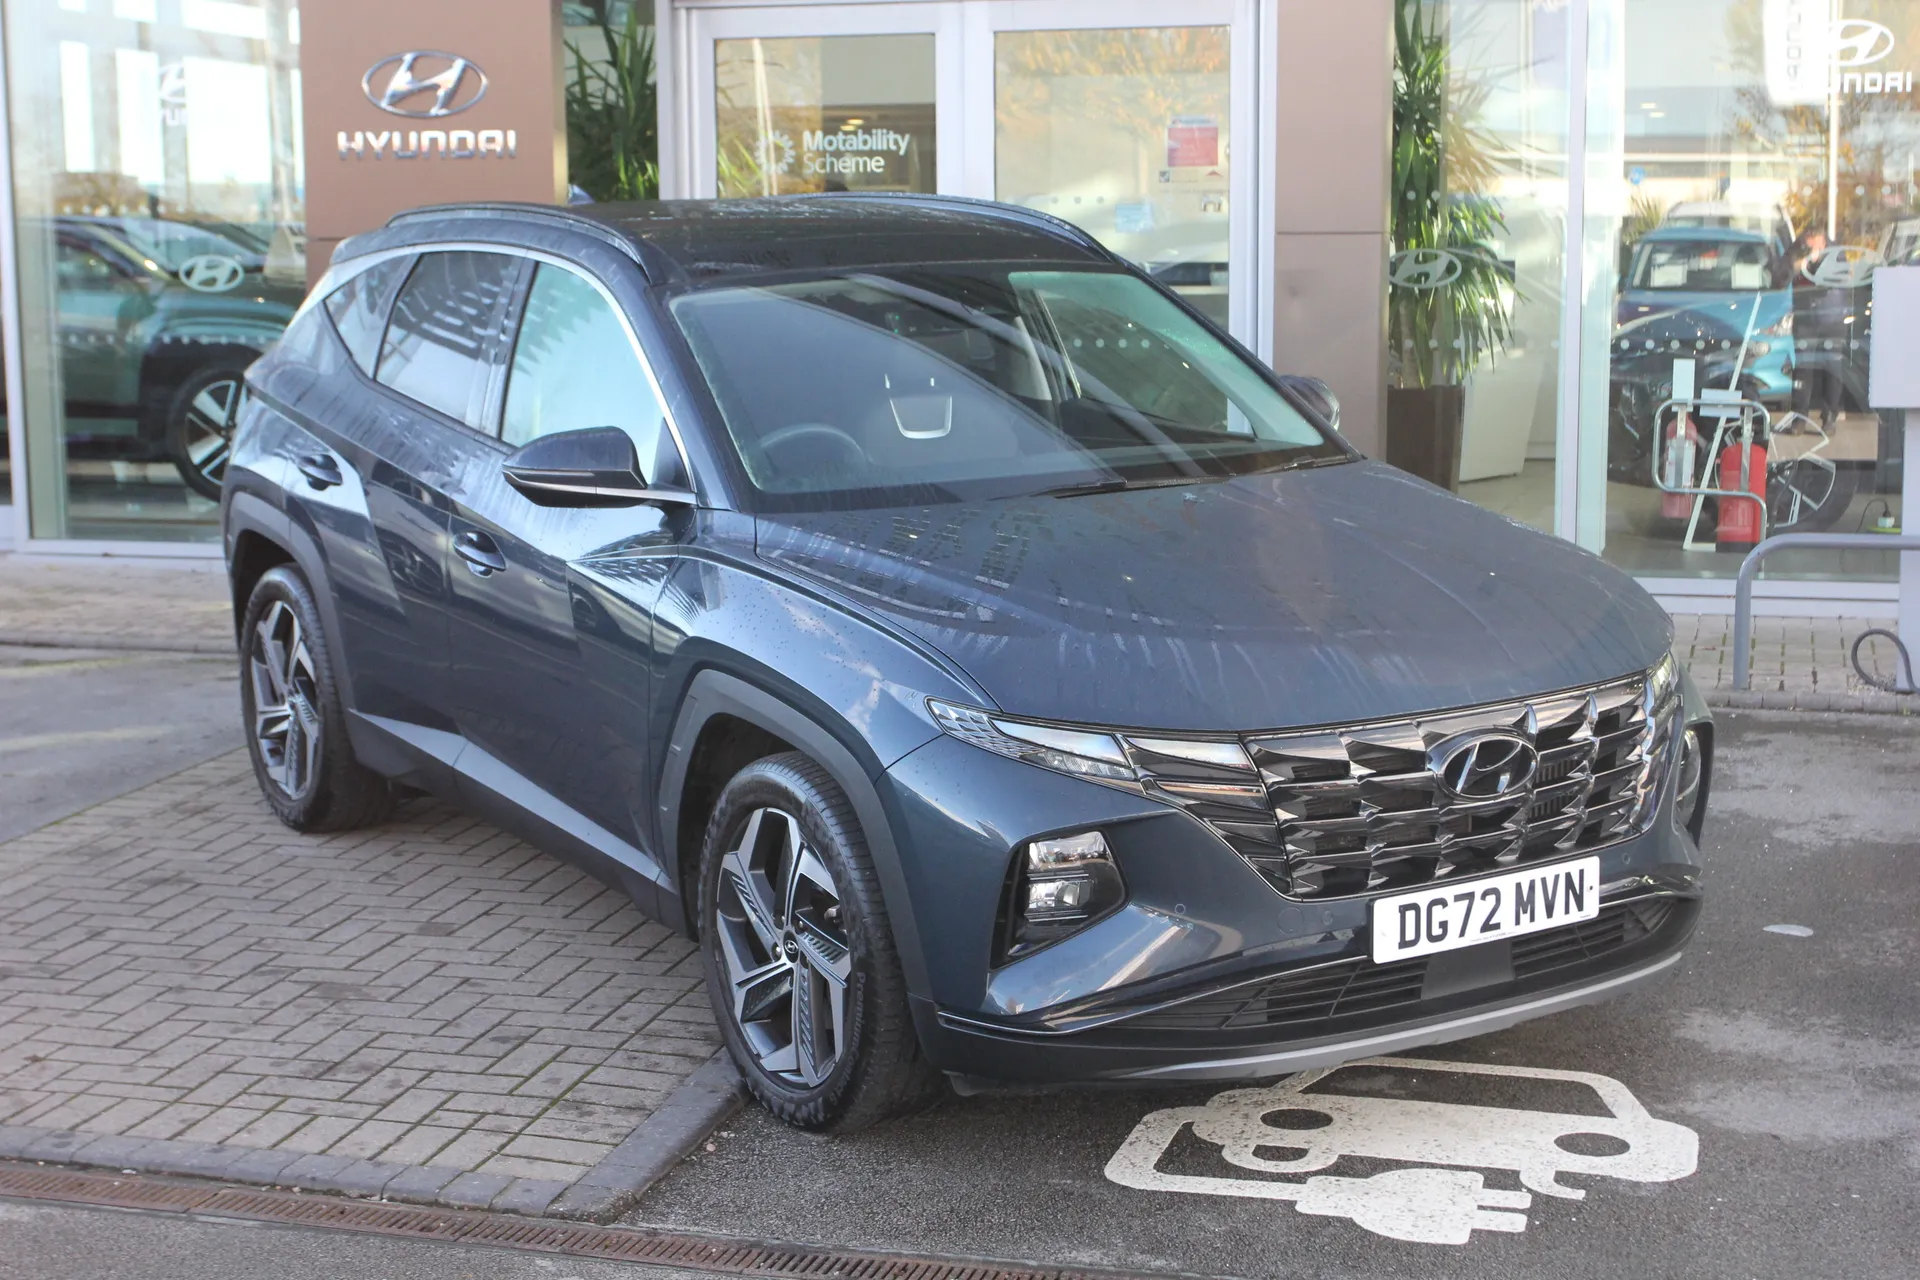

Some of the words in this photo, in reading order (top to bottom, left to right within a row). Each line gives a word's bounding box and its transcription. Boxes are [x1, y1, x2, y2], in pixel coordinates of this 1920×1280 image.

[1836, 71, 1913, 94] NDAI
[337, 129, 517, 161] HYUNDAI
[802, 128, 910, 156] Motability
[803, 152, 885, 174] Scheme
[1398, 886, 1502, 950] DG72
[1514, 868, 1586, 927] MVN
